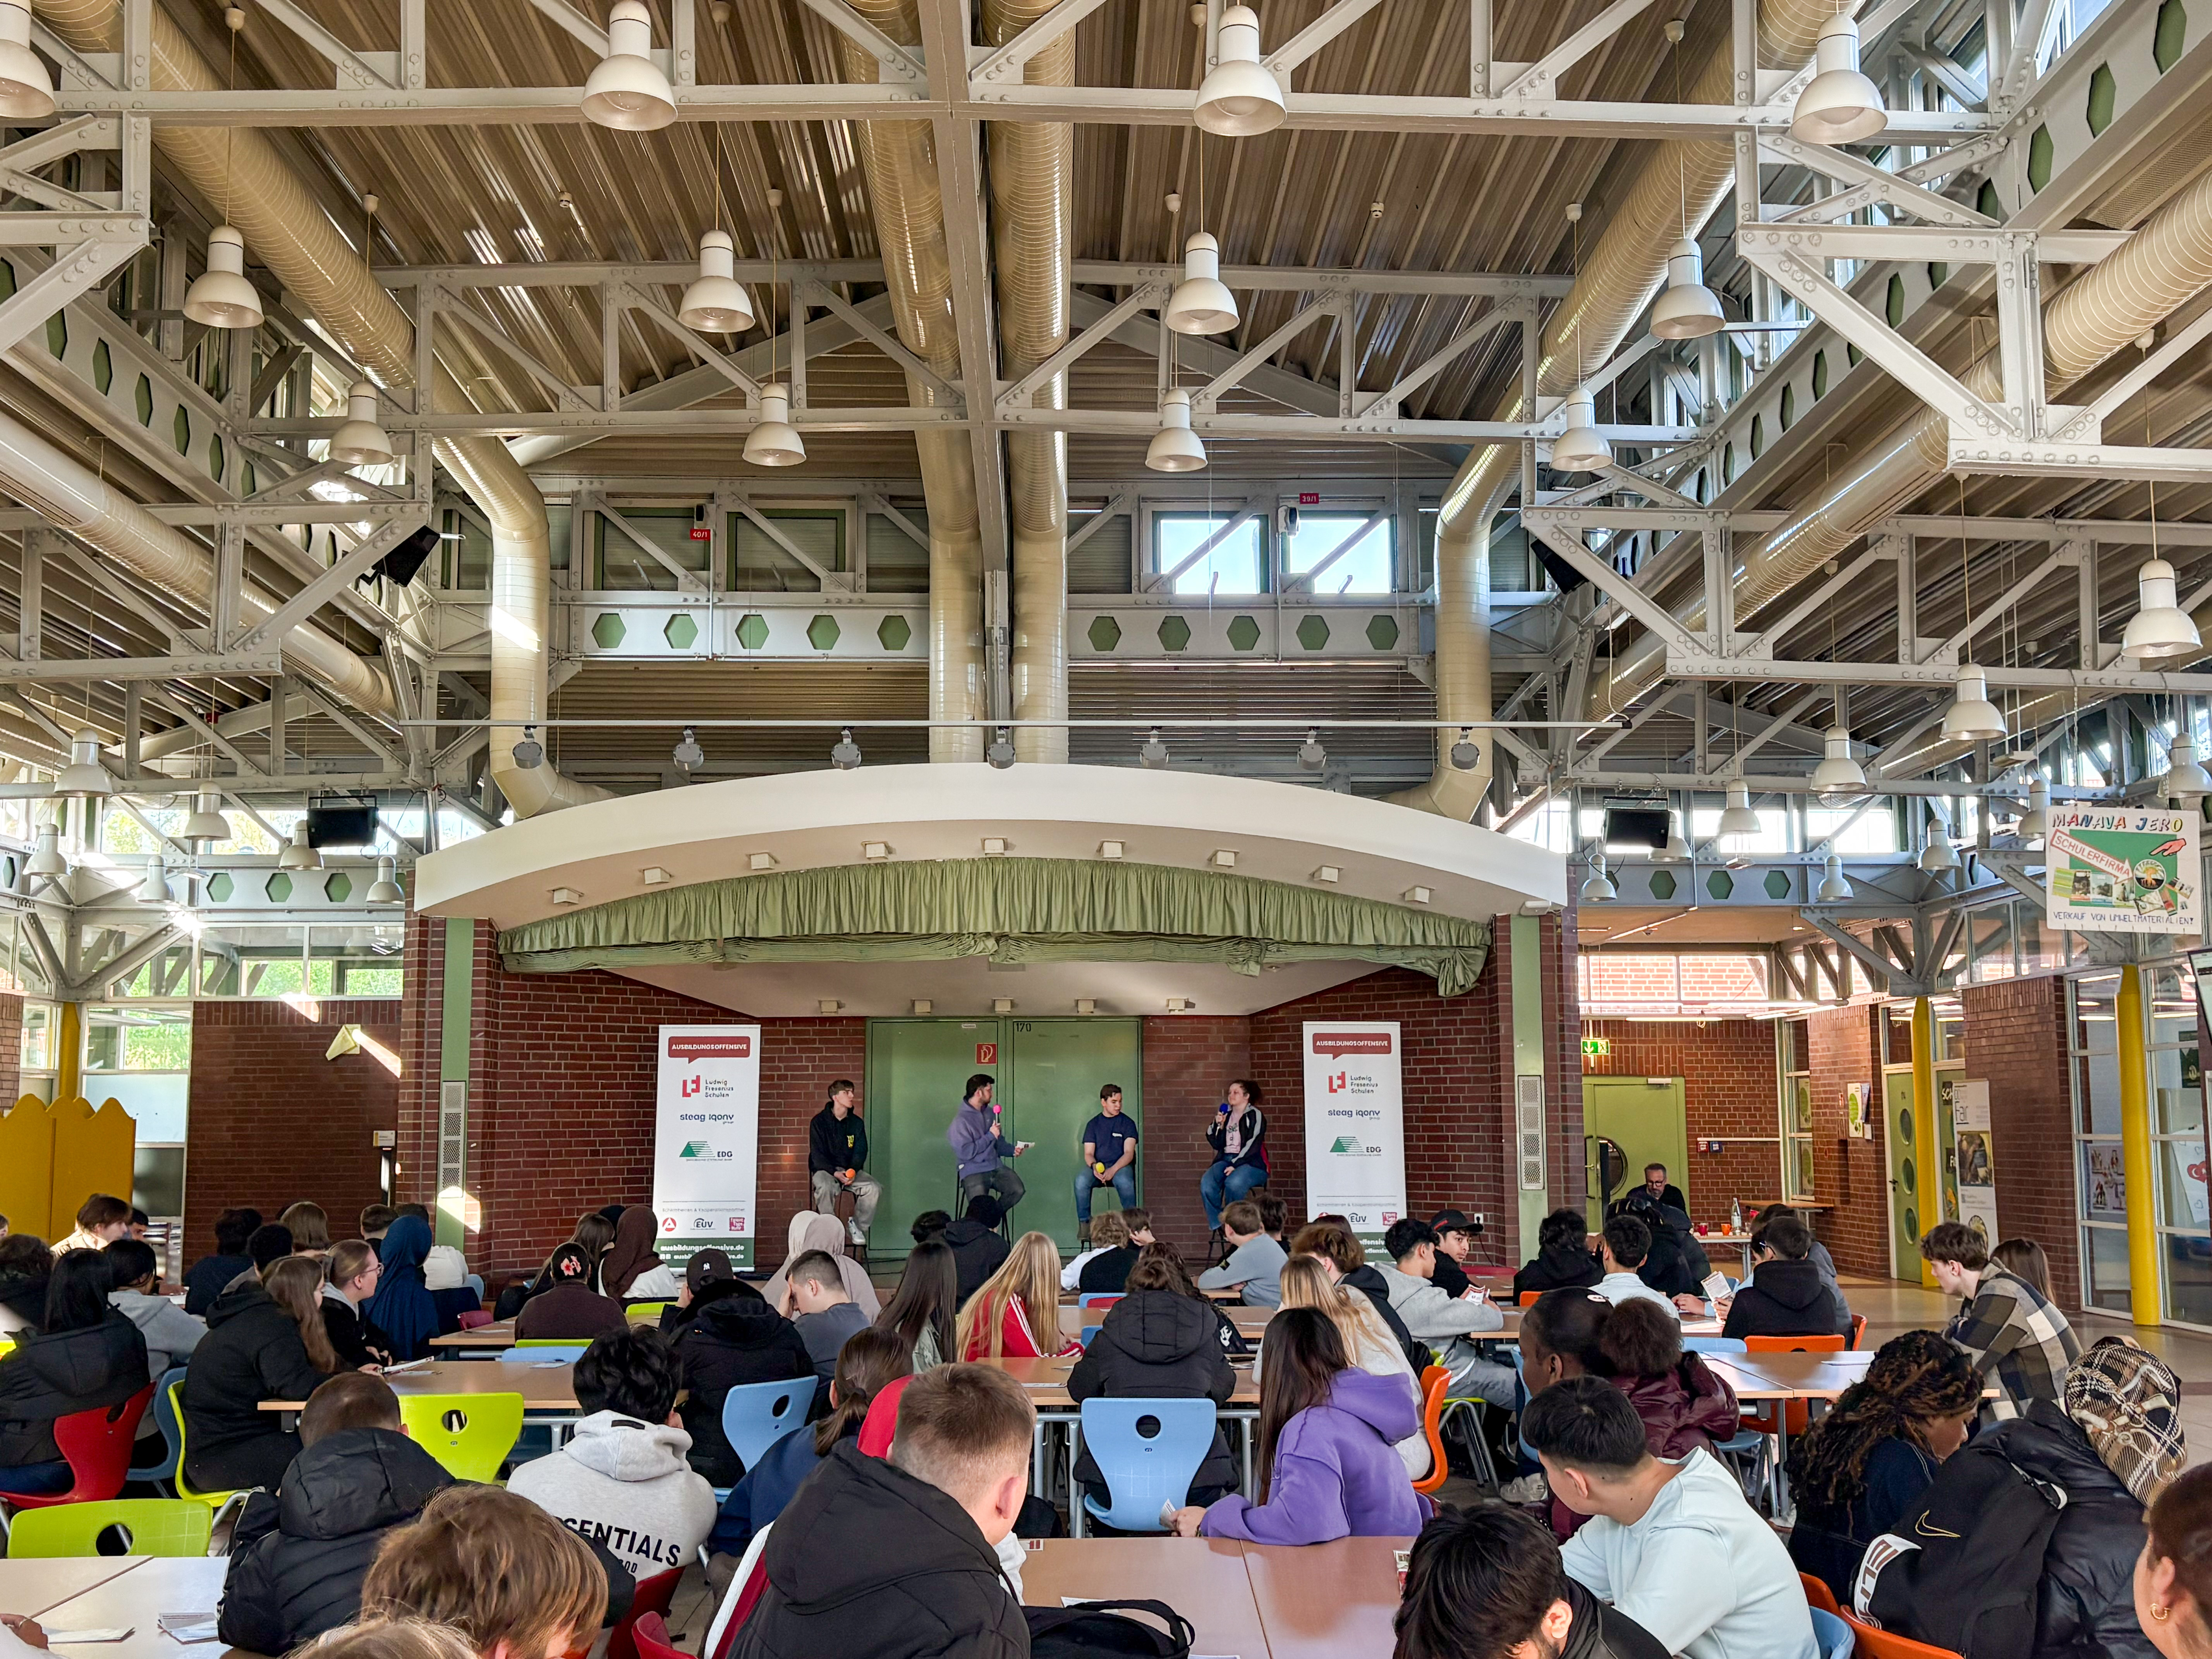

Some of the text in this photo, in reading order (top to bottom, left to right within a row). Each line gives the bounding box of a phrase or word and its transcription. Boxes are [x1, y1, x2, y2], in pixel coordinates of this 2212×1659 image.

[2052, 813, 2183, 832] MANAVA JERO
[2053, 912, 2086, 920] VERKAUF
[2091, 913, 2106, 921] VON
[1016, 1023, 1031, 1032] 170
[680, 1114, 705, 1122] steag
[1328, 1109, 1353, 1118] steag
